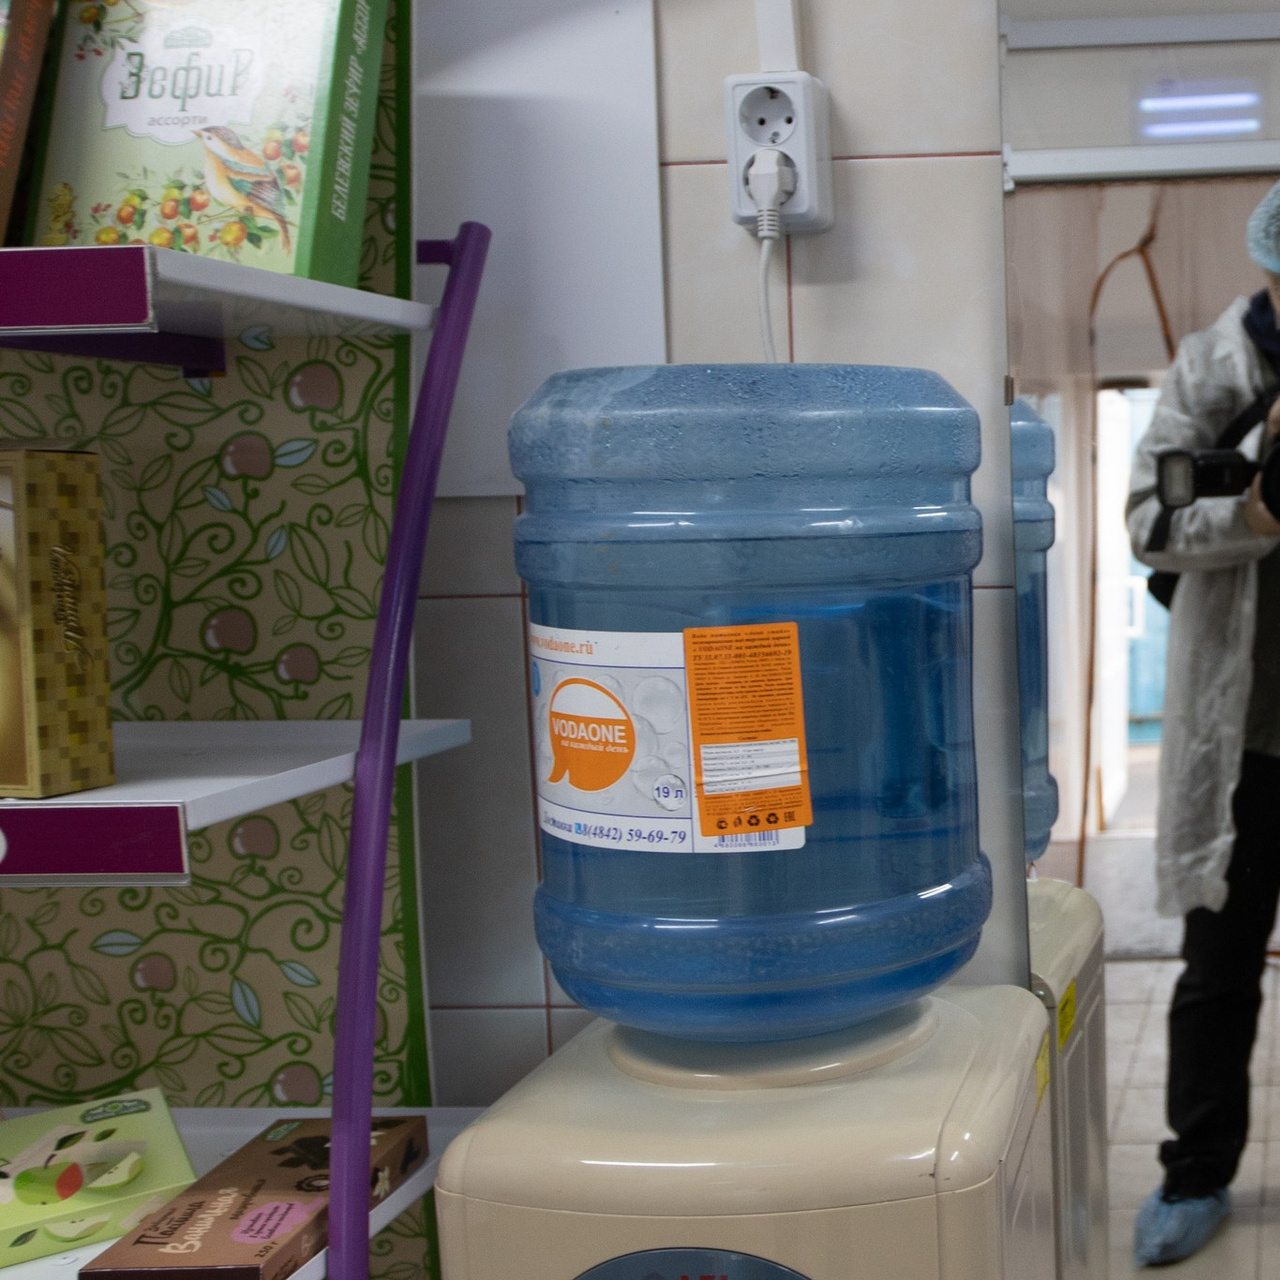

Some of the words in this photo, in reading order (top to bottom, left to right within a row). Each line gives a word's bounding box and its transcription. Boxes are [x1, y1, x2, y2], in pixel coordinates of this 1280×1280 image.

[146, 114, 208, 129] ассорти
[330, 113, 358, 222] БЕЛЕВСКИЙ
[346, 53, 367, 117] ЗЕФИР
[552, 717, 627, 744] VODAONE
[655, 786, 670, 798] 19
[674, 788, 684, 799] л
[582, 822, 623, 842] 8(4842)
[627, 828, 687, 844] 59-69-79
[157, 1186, 239, 1255] Ванильная
